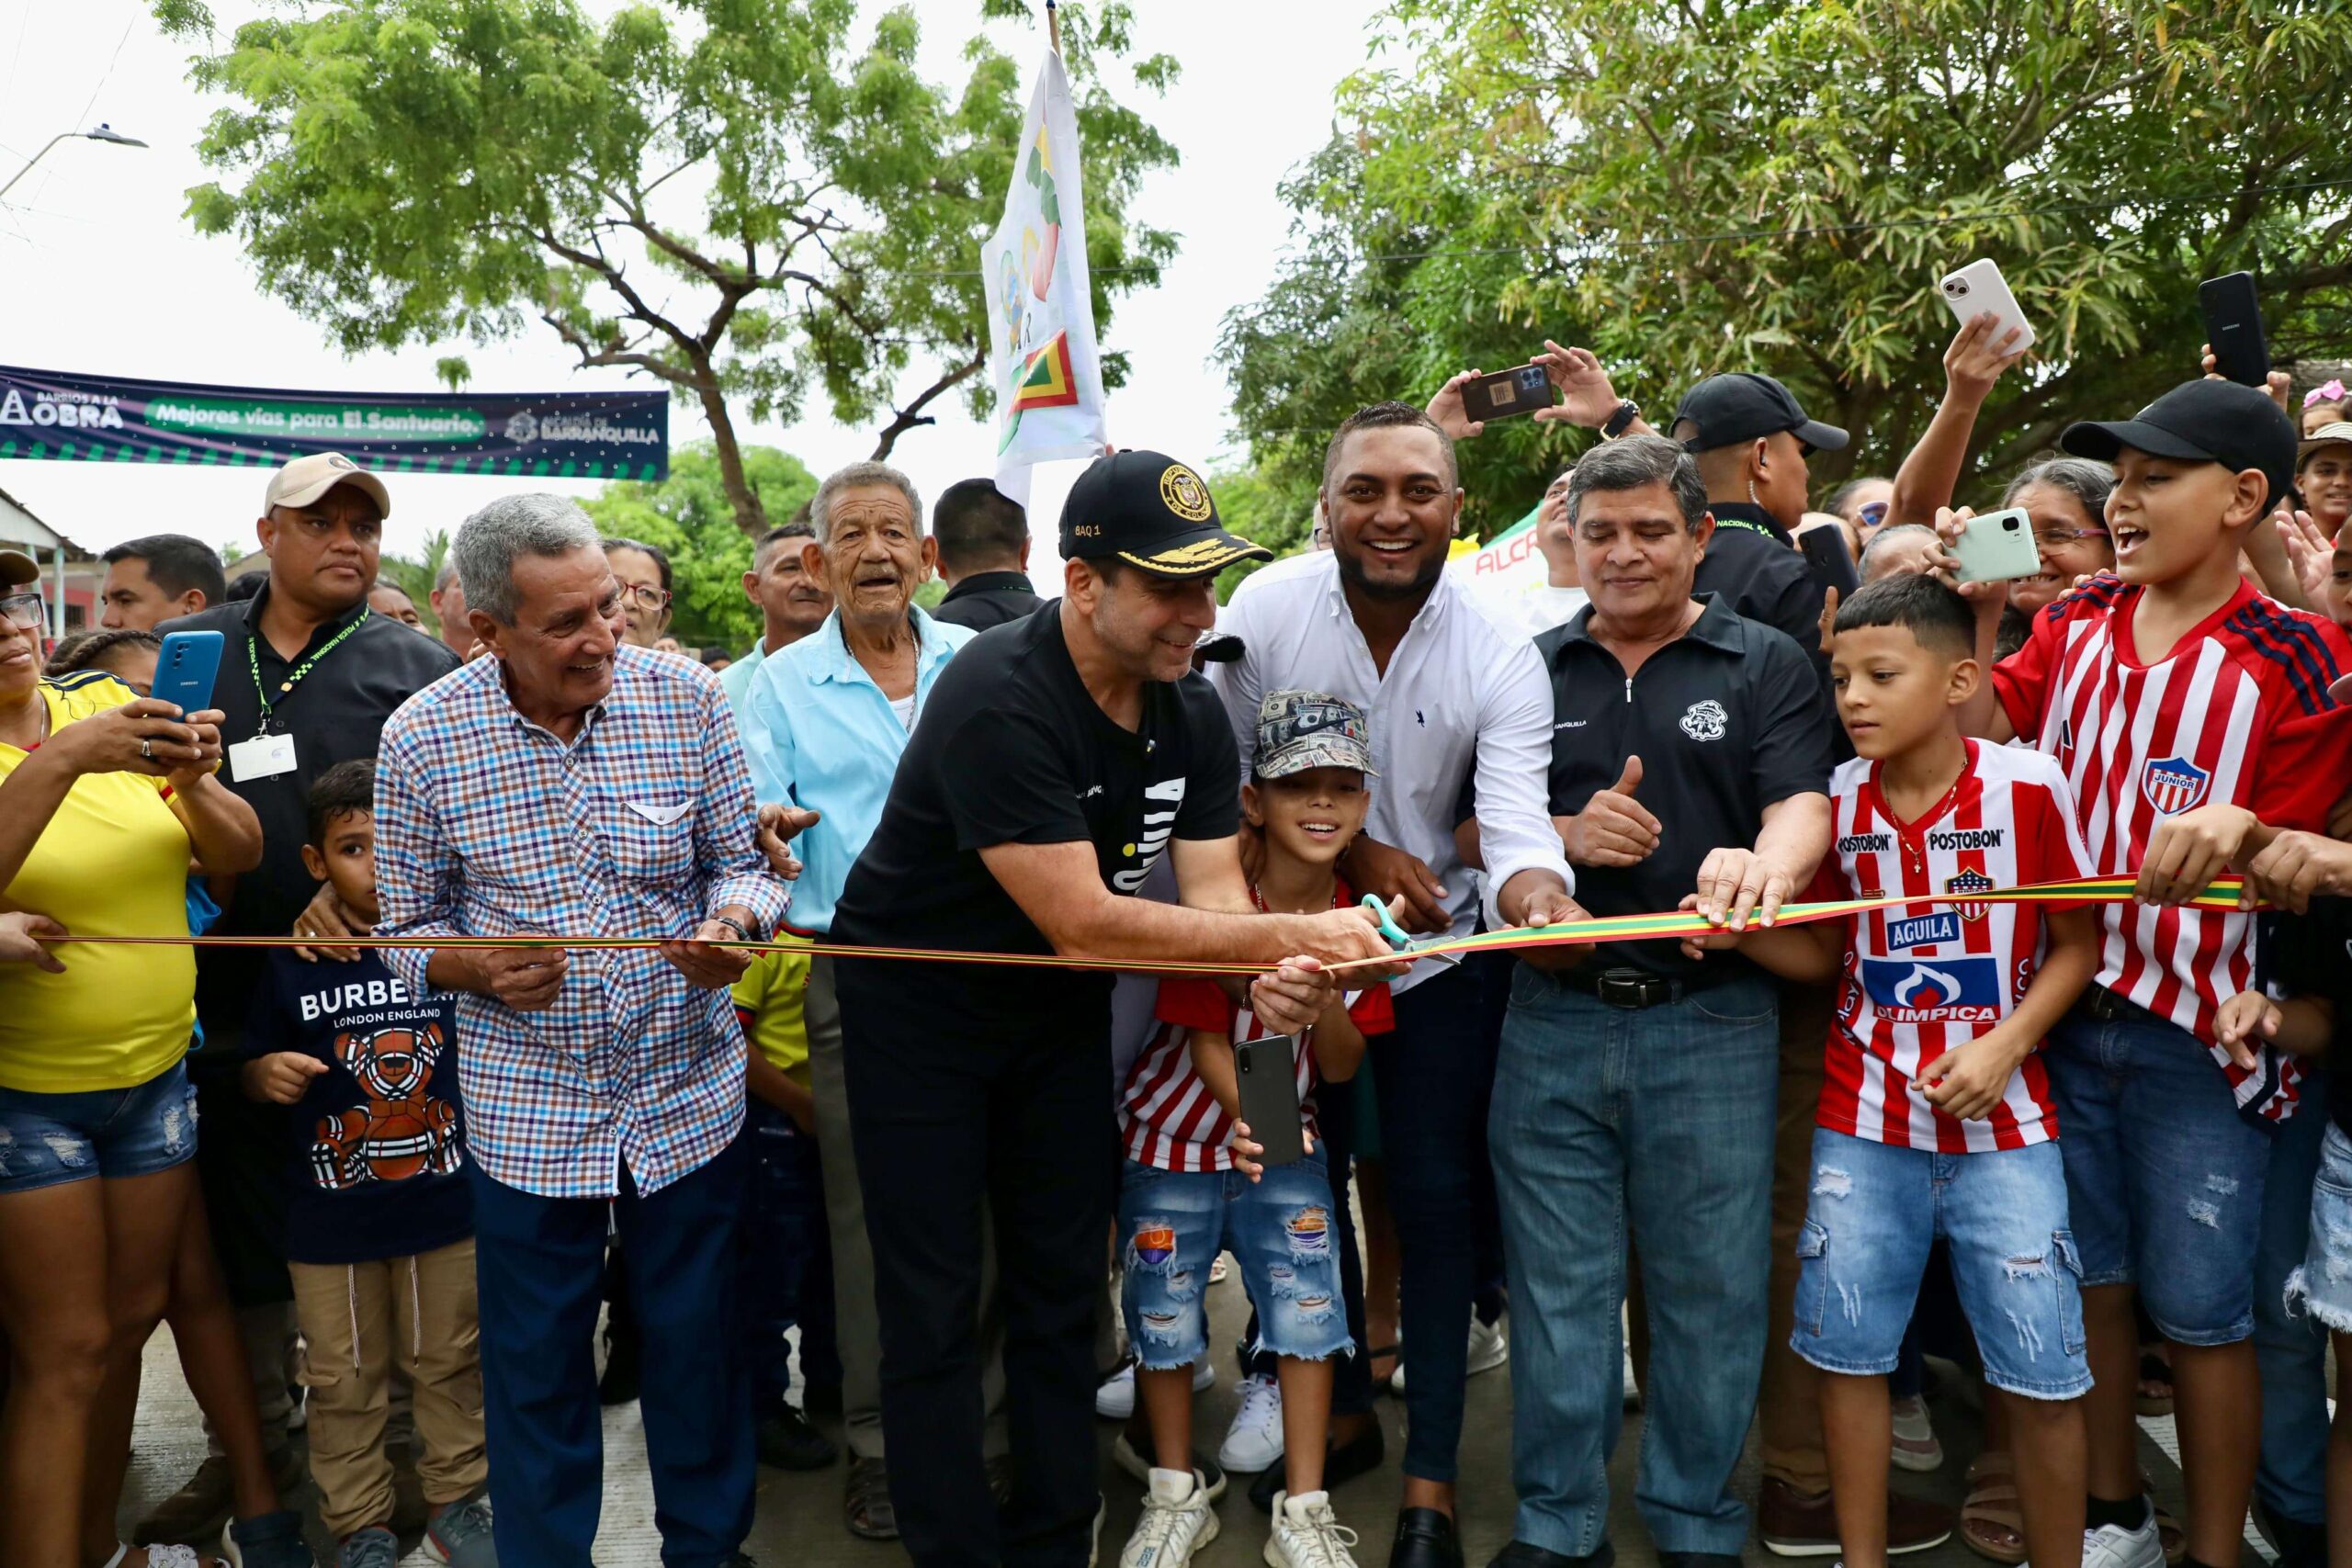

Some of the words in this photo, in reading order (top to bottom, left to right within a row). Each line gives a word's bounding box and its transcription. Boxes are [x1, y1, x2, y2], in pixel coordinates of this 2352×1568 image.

[37, 392, 89, 404] BARRIOS
[92, 394, 100, 404] A
[103, 396, 119, 406] LA
[155, 403, 240, 426] Mejores
[244, 407, 285, 426] vías
[289, 412, 338, 431] para
[343, 411, 362, 429] El
[367, 412, 480, 433] Santuario.
[594, 417, 607, 427] DE
[540, 425, 660, 444] BARRANQUILLA
[1093, 525, 1101, 536] 1
[1716, 519, 1754, 530] NACIONAL
[310, 637, 340, 660] NACIONAL
[2154, 774, 2195, 788] JUNIOR
[1893, 917, 1954, 946] AGUILA
[334, 1013, 384, 1028] LONDON
[388, 1009, 441, 1021] ENGLAND
[1877, 1006, 1996, 1022] OLIMPICA
